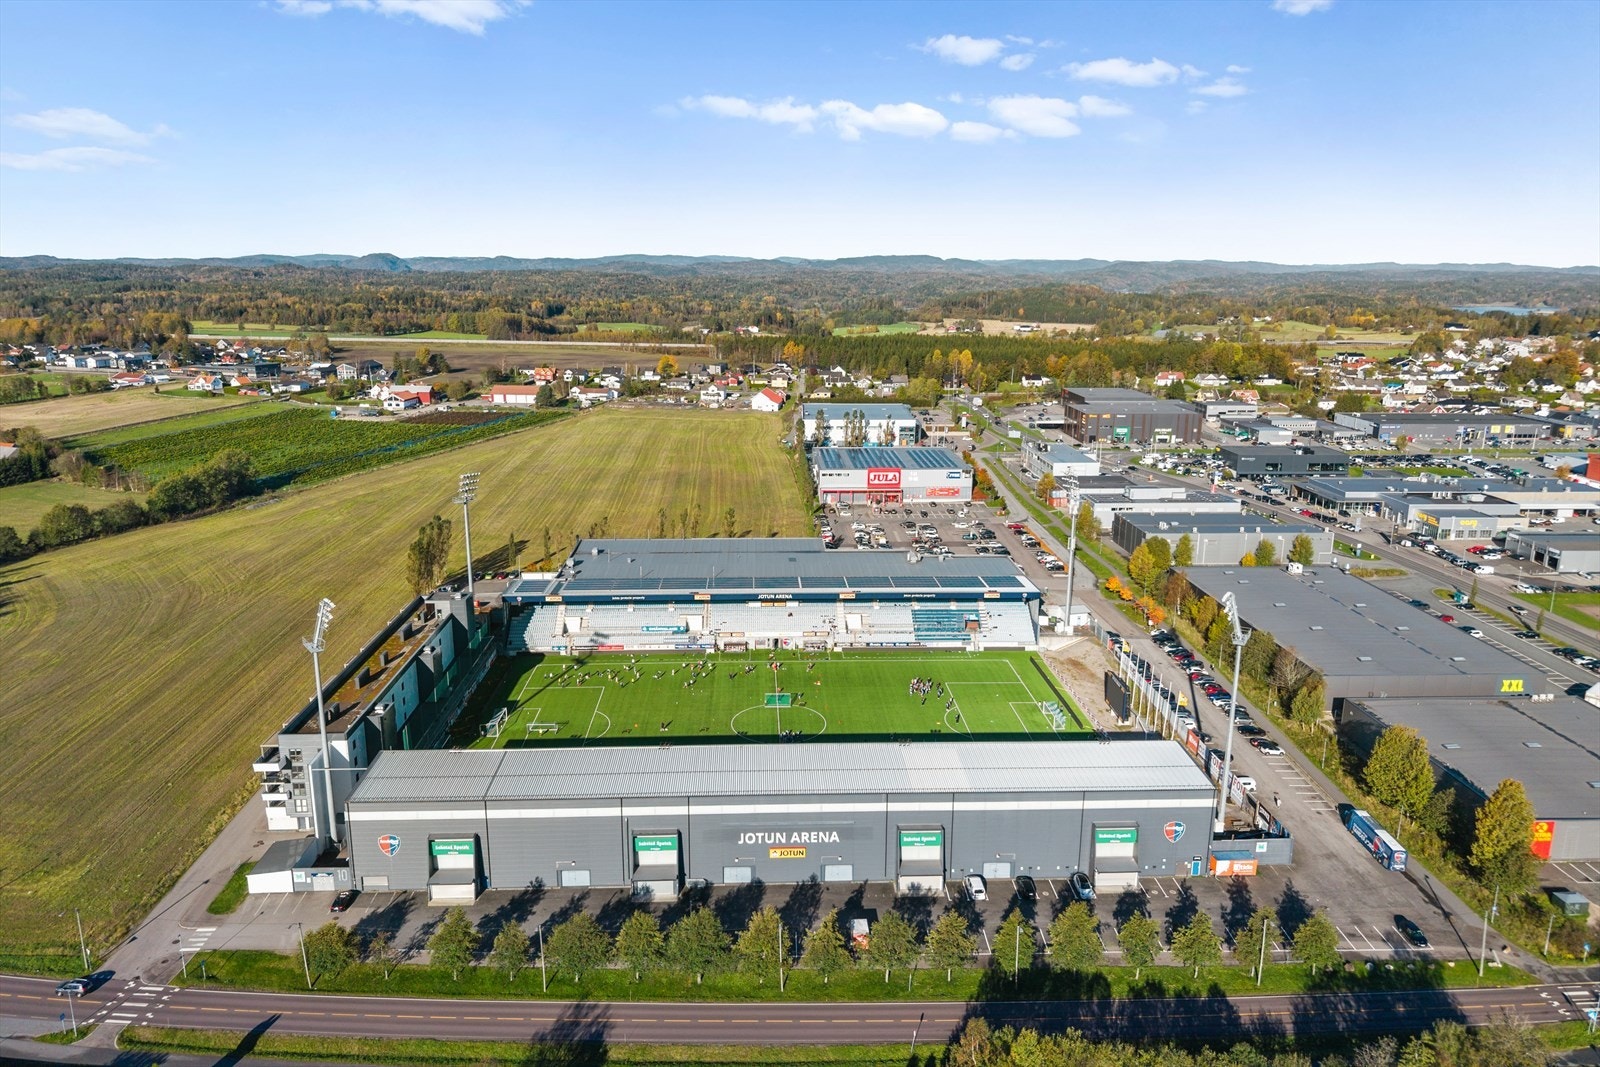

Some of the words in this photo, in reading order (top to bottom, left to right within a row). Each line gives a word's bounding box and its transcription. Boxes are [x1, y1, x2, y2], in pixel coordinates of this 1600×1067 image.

[870, 474, 898, 482] JULA
[1501, 679, 1524, 692] XXL
[738, 832, 786, 844] JOTUN
[790, 831, 840, 843] ARENA
[336, 869, 348, 881] 10
